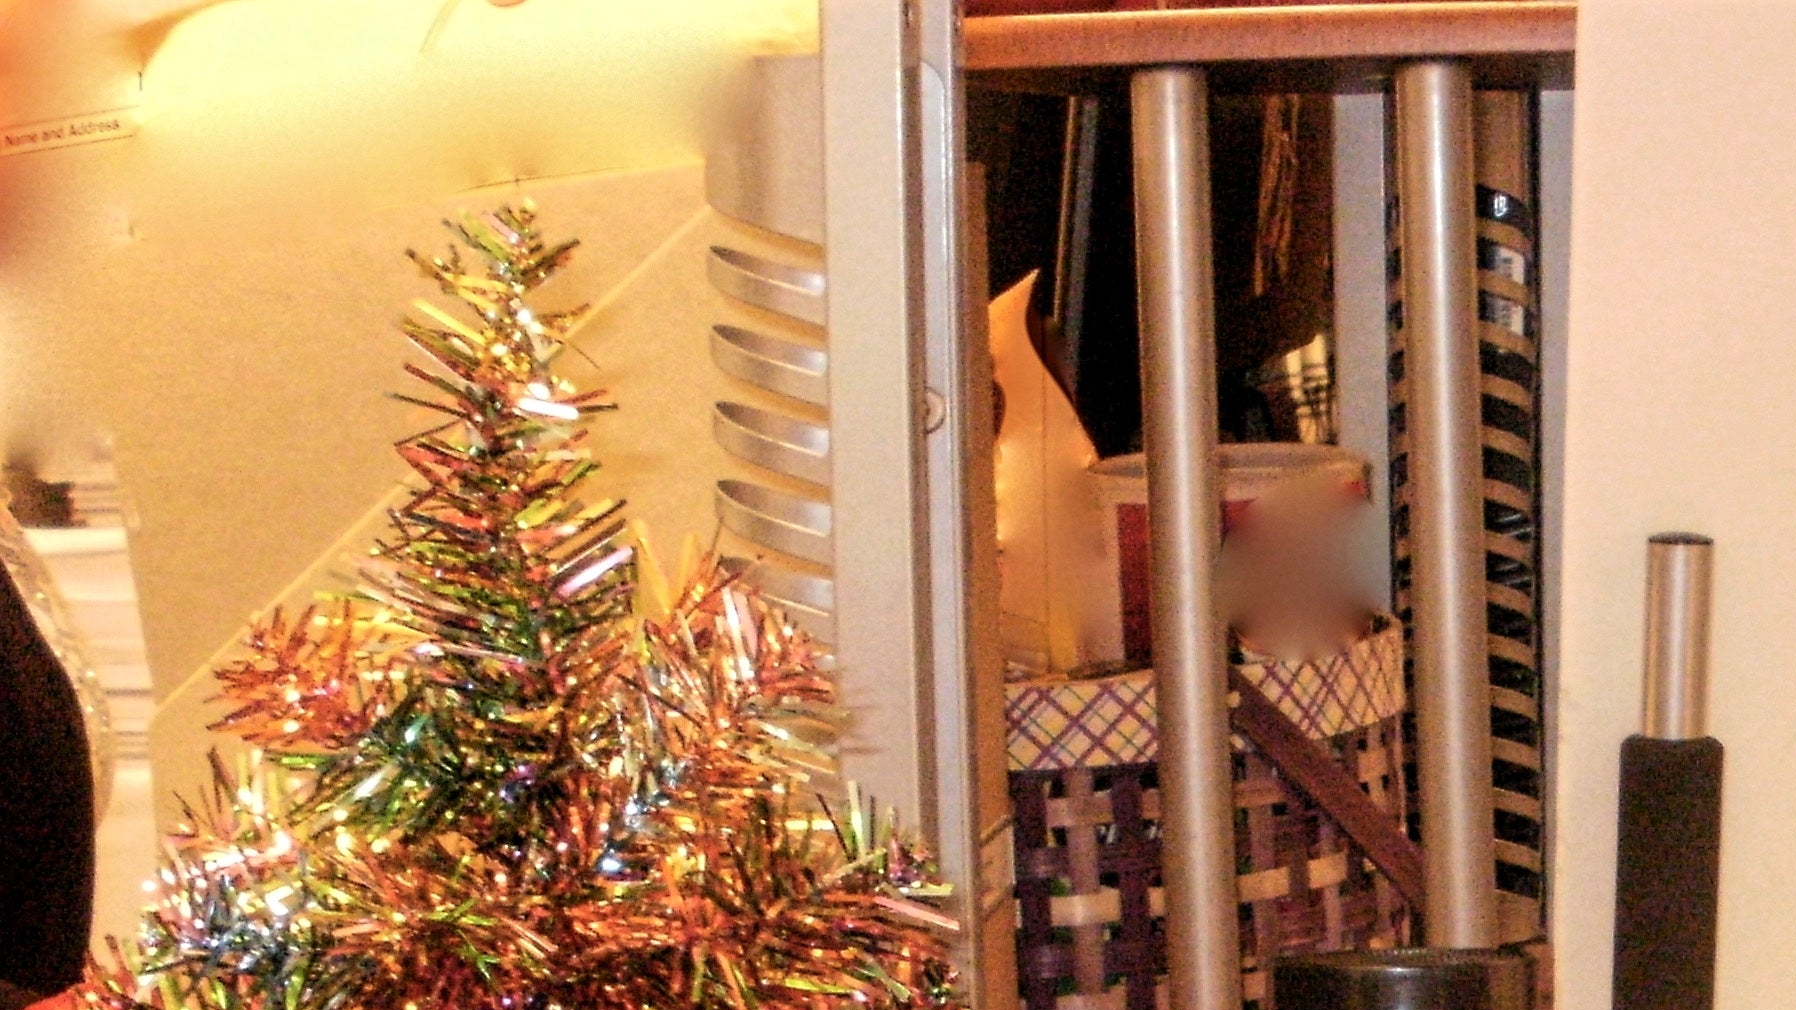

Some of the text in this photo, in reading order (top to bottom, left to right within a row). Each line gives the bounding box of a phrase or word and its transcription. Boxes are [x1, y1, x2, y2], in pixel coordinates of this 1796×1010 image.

[5, 119, 120, 146] Name and Address
